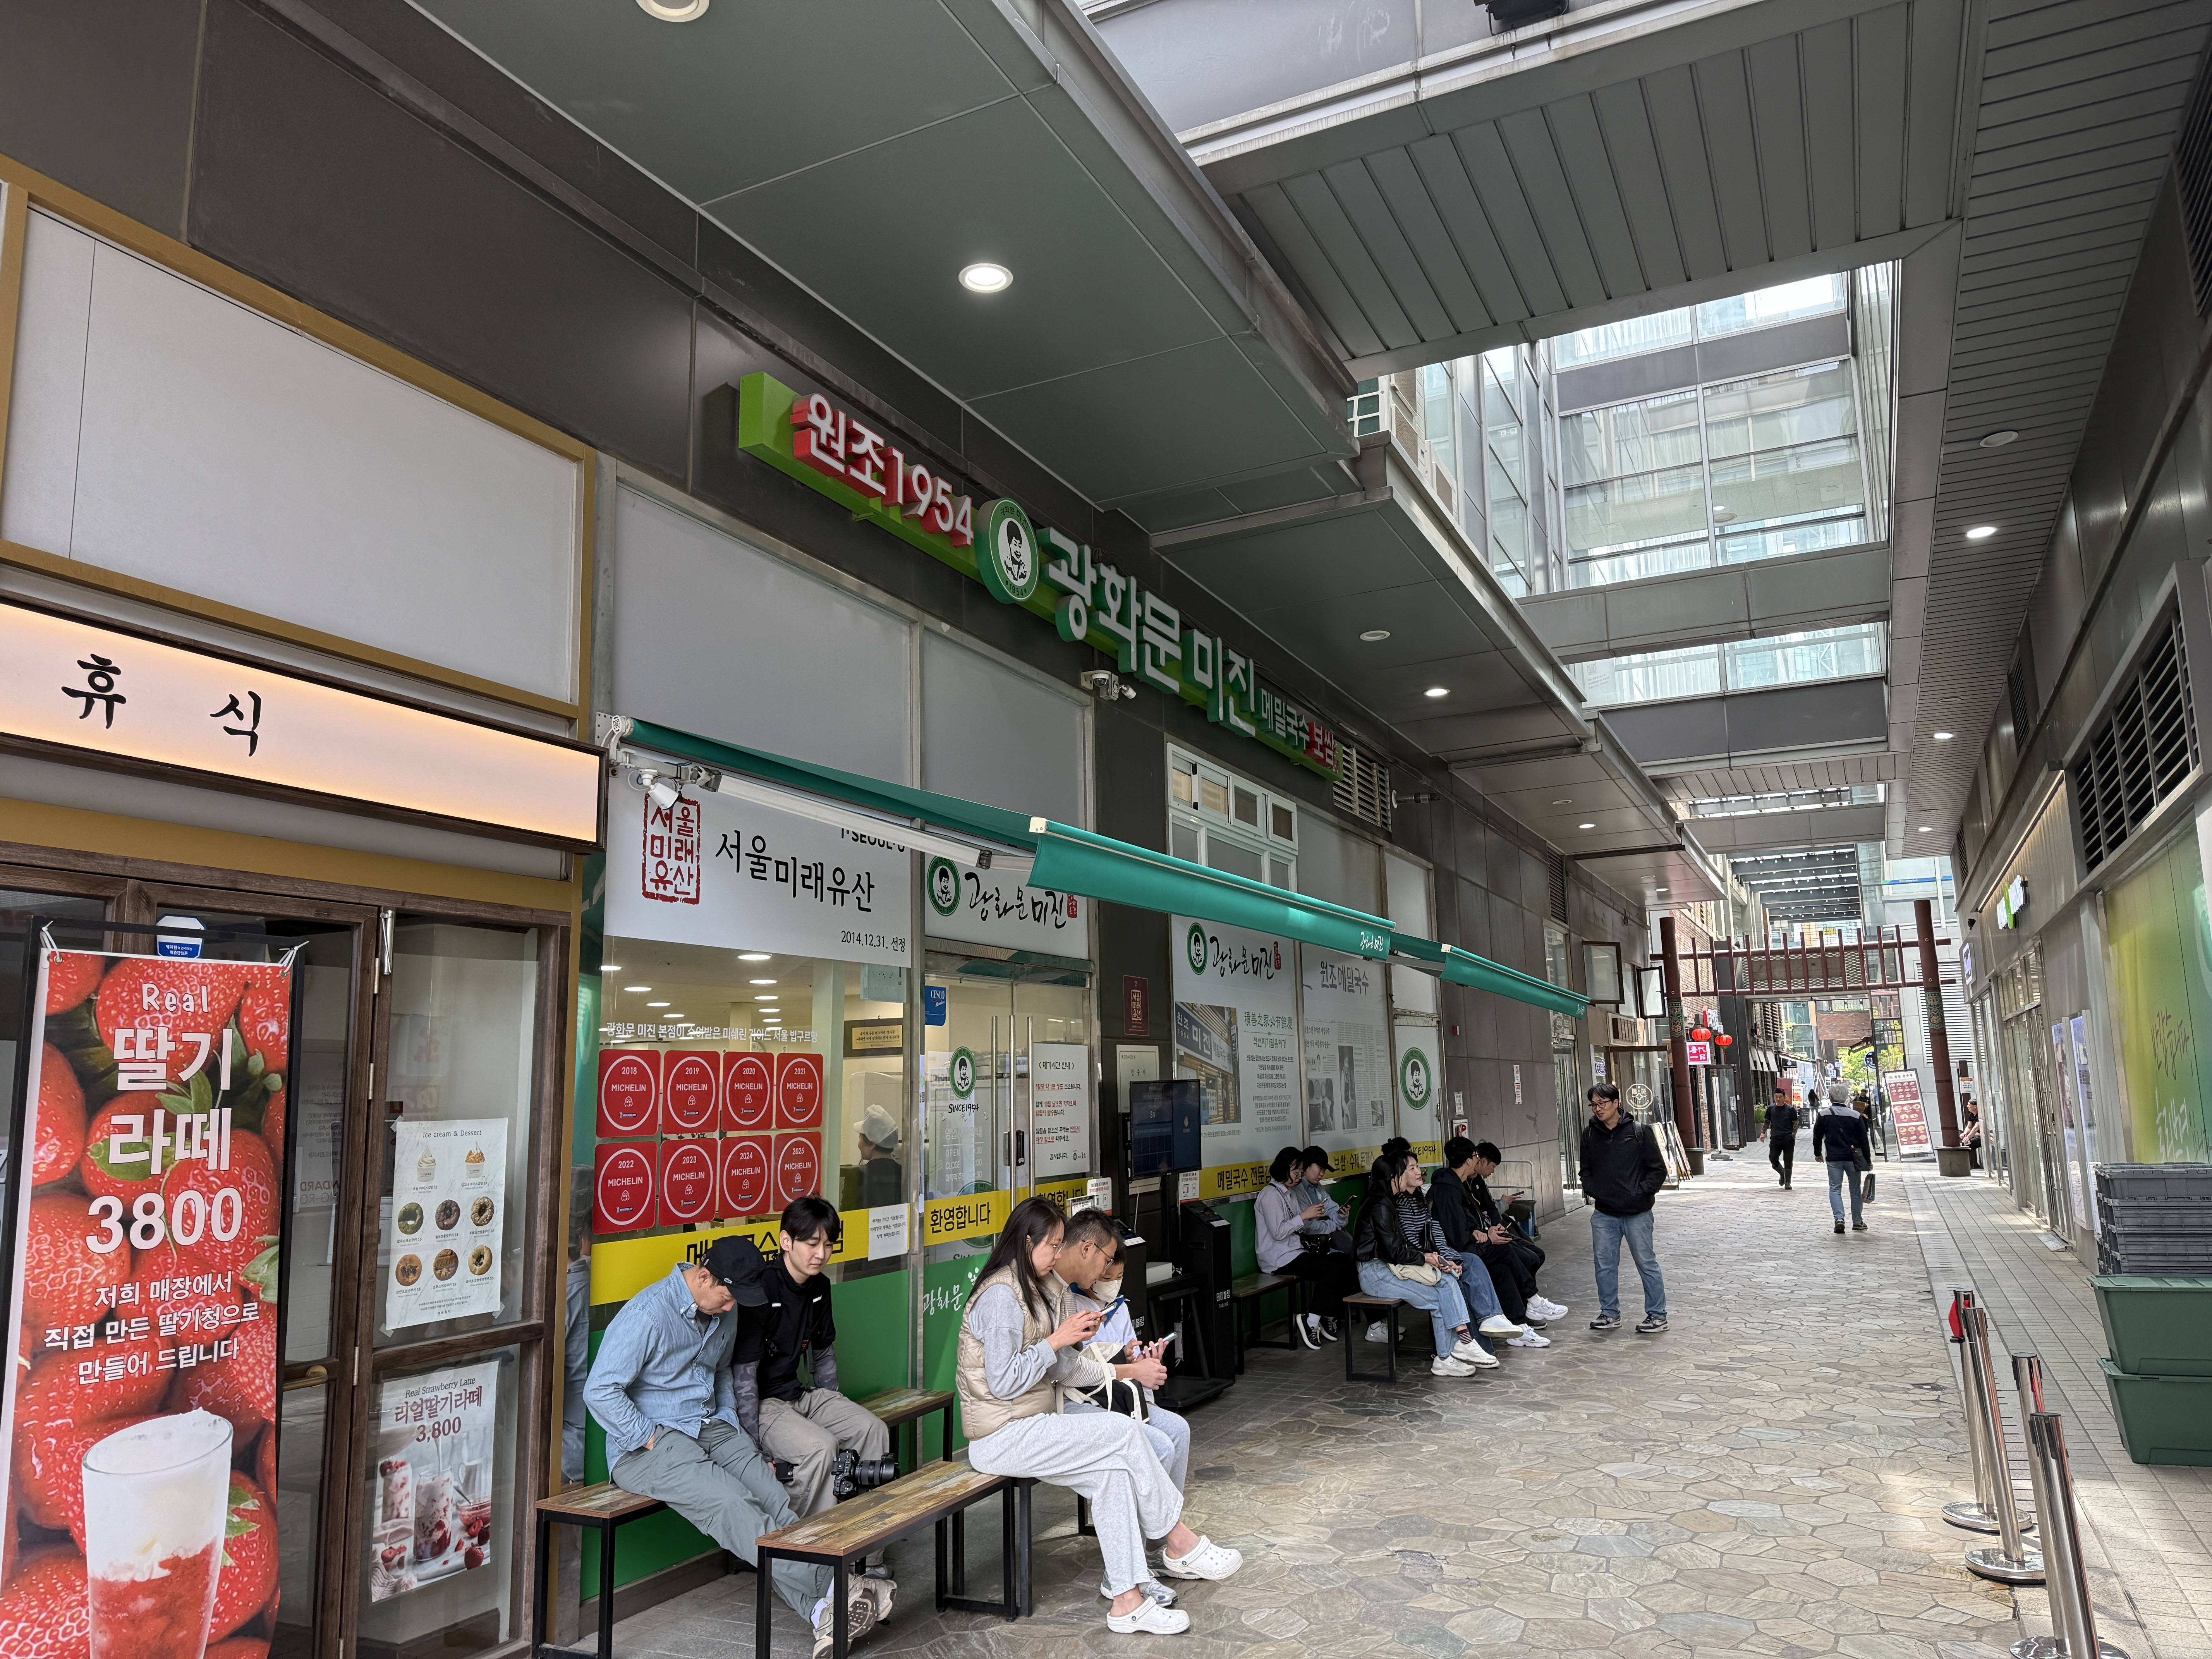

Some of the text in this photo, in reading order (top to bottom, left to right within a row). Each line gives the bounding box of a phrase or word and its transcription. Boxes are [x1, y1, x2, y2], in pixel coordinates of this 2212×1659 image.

[651, 805, 695, 838] 서울
[651, 835, 694, 864] 미래
[650, 860, 694, 895] 유산
[891, 936, 905, 952] 선정
[142, 983, 209, 1013] Real
[606, 1022, 635, 1037] 광화문
[638, 1024, 656, 1038] 미진
[658, 1025, 685, 1039] 본점이
[723, 1028, 746, 1041] 미쉐린
[774, 1029, 788, 1042] 서울
[790, 1029, 818, 1043] 빕구르망
[1192, 1024, 1211, 1056] 미진
[113, 1026, 233, 1091] 딸기
[1042, 1061, 1071, 1070] 대기시간 안내
[622, 1066, 637, 1075] 2018
[685, 1067, 699, 1075] 2019
[742, 1067, 756, 1075] 2020
[611, 1084, 646, 1092] MICHELIN
[676, 1083, 708, 1091] MICHELIN
[108, 1108, 232, 1175] 라떼
[618, 1160, 634, 1169] 2022
[682, 1156, 697, 1164] 2023
[740, 1152, 753, 1160] 2024
[785, 1162, 811, 1170] MICHELIN
[608, 1176, 643, 1187] MICHELIN
[673, 1171, 705, 1181] MICHELIN
[731, 1167, 761, 1176] MICHELIN
[1217, 1167, 1248, 1192] 메밀국수
[85, 1187, 243, 1254] 3800
[930, 1202, 991, 1234] 환영합니다
[94, 1271, 232, 1308] 저희 매장에서
[44, 1302, 259, 1352] 직접 만든 딸기청으로
[78, 1337, 240, 1385] 만들어 드립니다
[405, 1376, 476, 1398] Real Strawberry Latte
[394, 1385, 483, 1425] 리얼딸기라떼
[416, 1416, 462, 1443] 3,800
